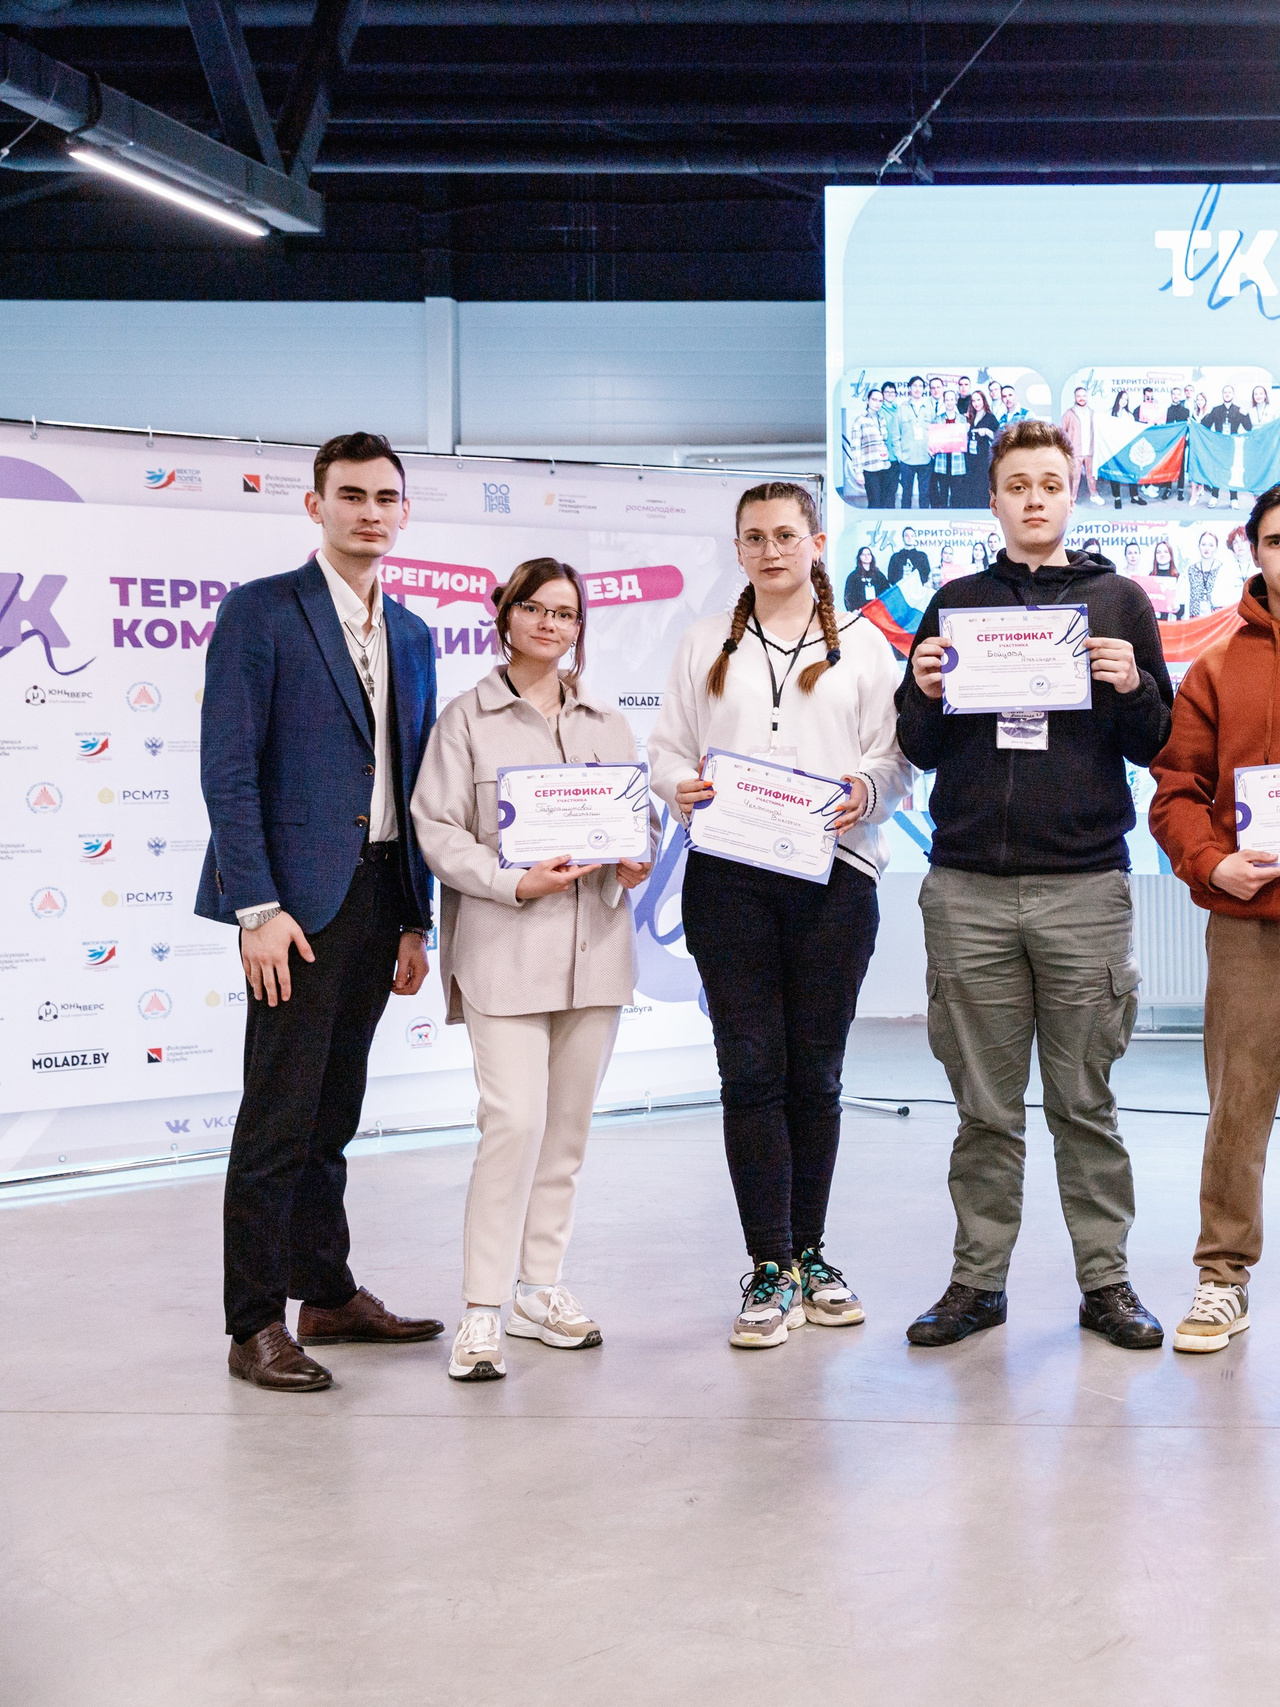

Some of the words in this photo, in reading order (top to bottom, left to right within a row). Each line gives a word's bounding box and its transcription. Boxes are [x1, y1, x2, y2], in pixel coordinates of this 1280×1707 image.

[110, 577, 228, 609] ТЕРР
[587, 574, 642, 601] ЕЗД
[113, 618, 214, 649] КОМ
[977, 632, 1054, 642] СЕРТИФИКАТ
[619, 696, 662, 706] MOLADZ.
[122, 790, 170, 800] РСМ73
[534, 787, 614, 798] СЕРТИФИКАТ
[736, 781, 813, 807] СЕРТИФИКАТ
[126, 890, 173, 903] РСМ73
[228, 991, 246, 1003] РС
[32, 1052, 110, 1070] MOLADZ.BY
[203, 1115, 237, 1129] VK.C
